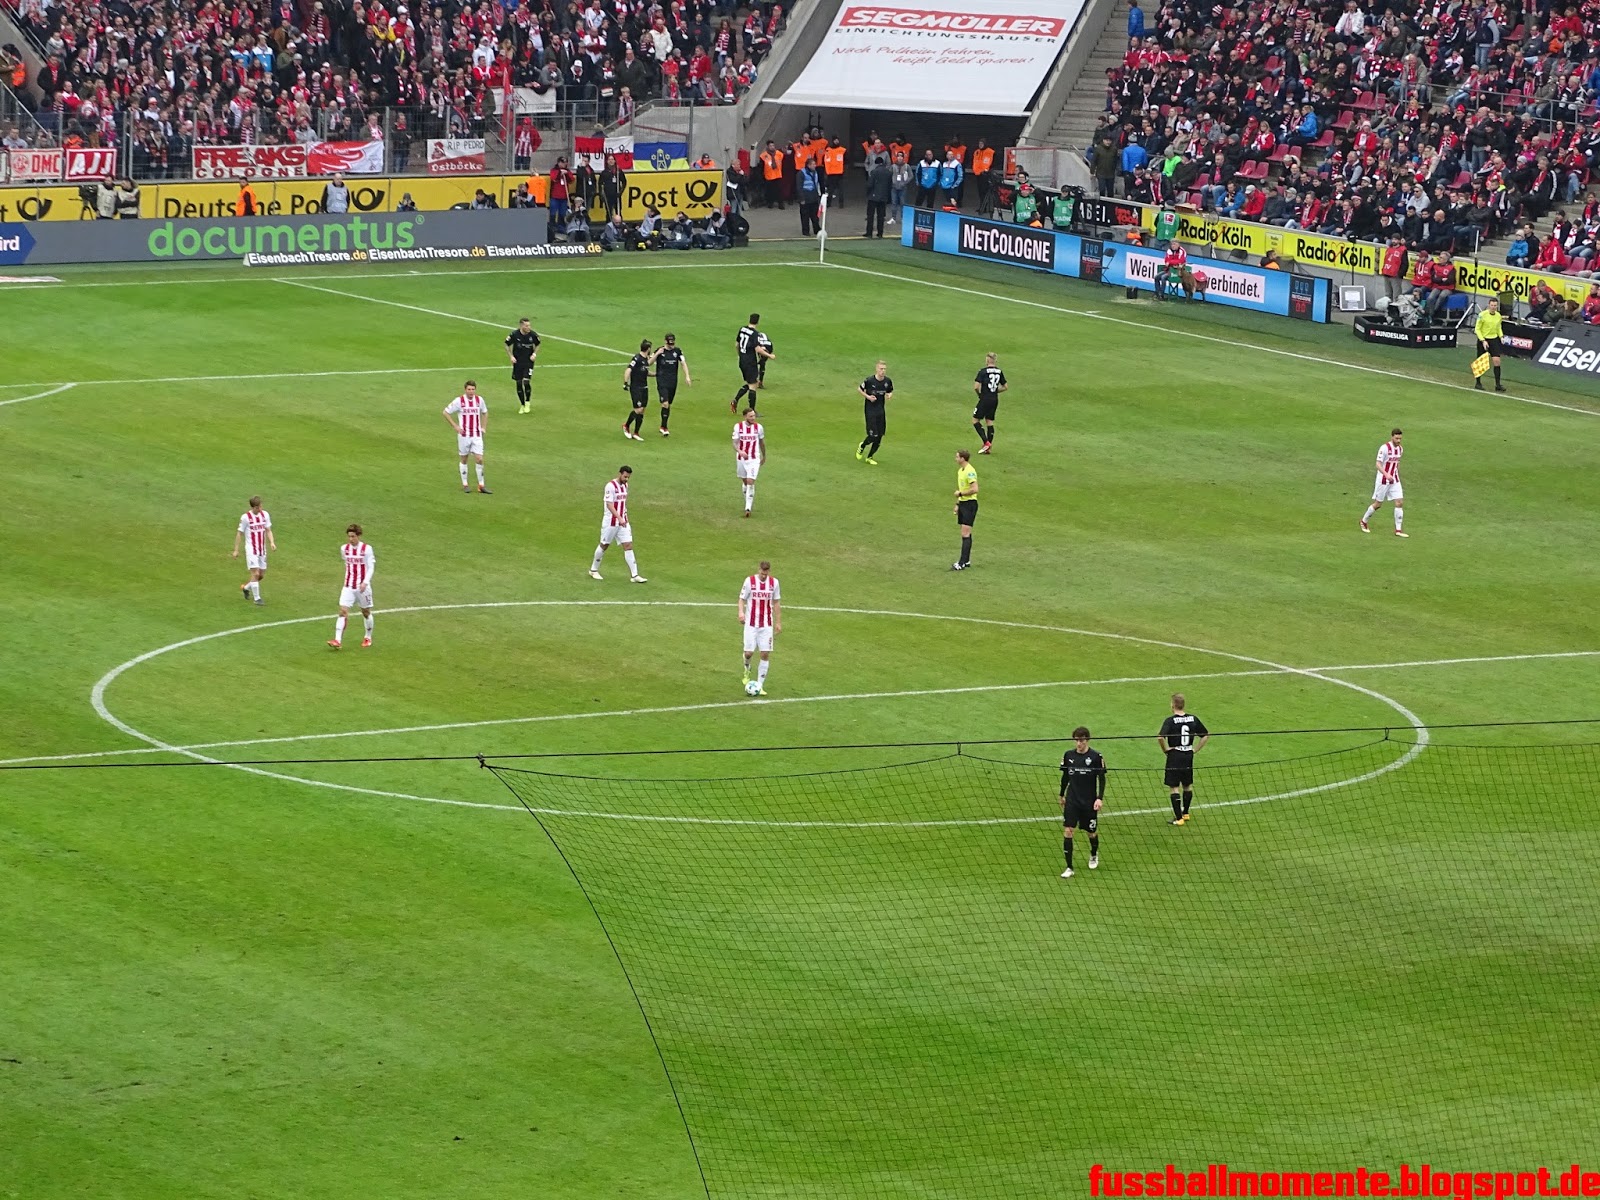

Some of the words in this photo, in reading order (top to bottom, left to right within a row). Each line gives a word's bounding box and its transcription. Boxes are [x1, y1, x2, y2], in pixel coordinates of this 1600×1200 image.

[847, 9, 1056, 34] SEGMÜLLER
[834, 27, 1056, 44] EINRICHTUNGSHÄUSER
[832, 45, 872, 55] Nach
[940, 47, 996, 57] fahren,
[892, 56, 932, 66] heißt
[935, 56, 977, 64] Geld
[976, 57, 1034, 66] sparen!
[463, 140, 485, 150] PEDRO
[31, 155, 61, 174] DMC
[194, 145, 306, 169] FREAKS
[195, 166, 304, 179] COLOGNE
[628, 186, 679, 210] Post
[148, 216, 415, 257] documentus
[1181, 218, 1218, 243] Radio
[1222, 226, 1252, 249] Köln
[249, 249, 366, 264] EisenbachTresore.de
[369, 246, 486, 260] EisenbachTresore.de
[487, 242, 601, 257] EisenbachTresore.de
[1297, 238, 1336, 263] Radio
[1340, 246, 1371, 269] Köln
[1130, 258, 1156, 279] Weil
[1459, 266, 1501, 292] Radio
[1375, 330, 1409, 341] BUNDESLIGA
[988, 373, 1000, 392] 32
[752, 591, 772, 599] REWE
[1181, 724, 1190, 746] 6
